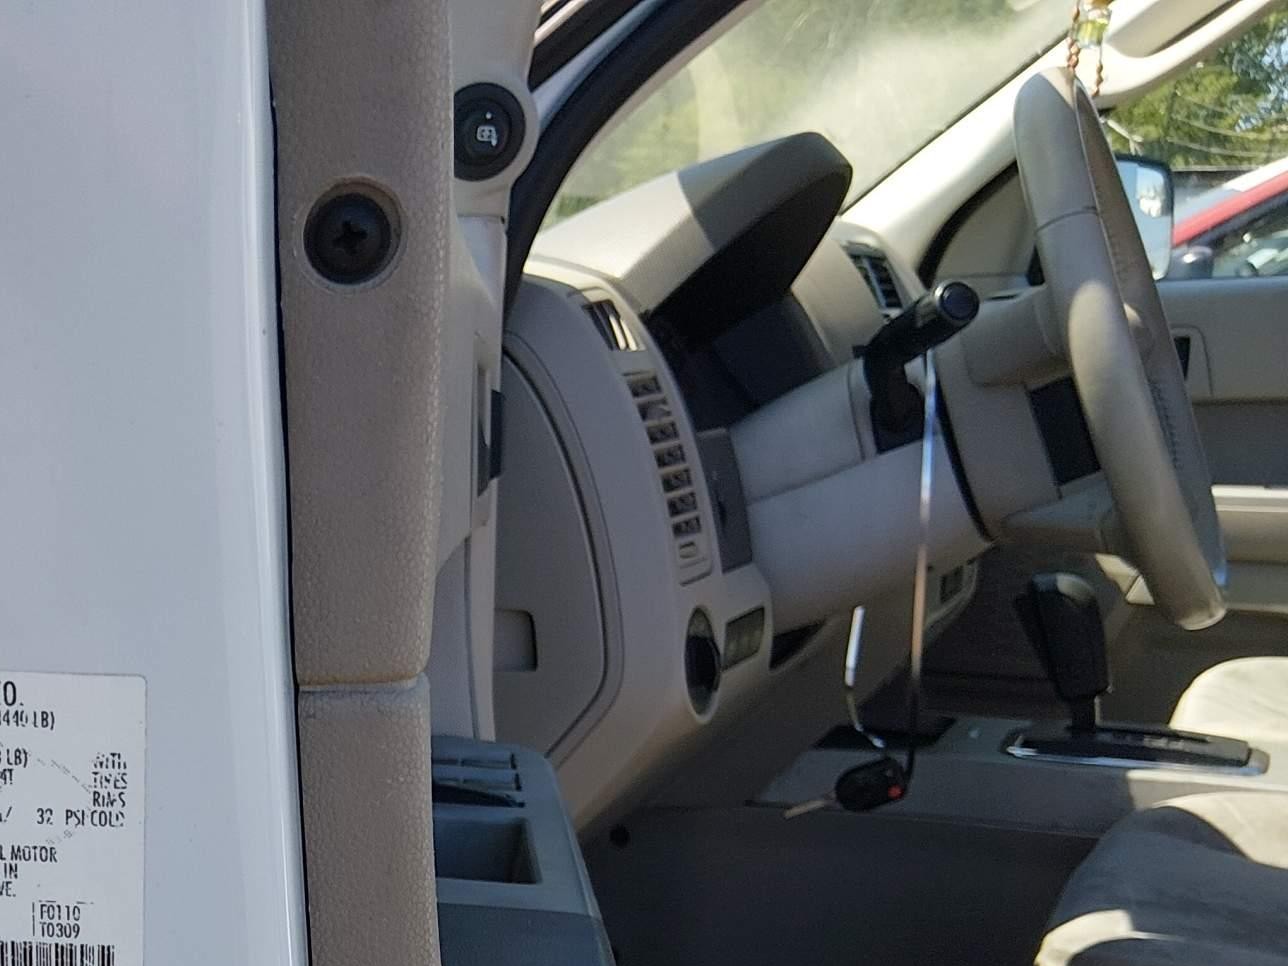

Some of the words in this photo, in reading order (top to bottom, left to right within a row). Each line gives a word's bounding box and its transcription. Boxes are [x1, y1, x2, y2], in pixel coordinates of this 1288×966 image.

[34, 711, 55, 730] LB)
[7, 748, 28, 767] LB)
[37, 808, 53, 825] 32
[65, 809, 85, 827] PSI
[11, 845, 57, 862] MOTOR
[4, 863, 17, 879] IN
